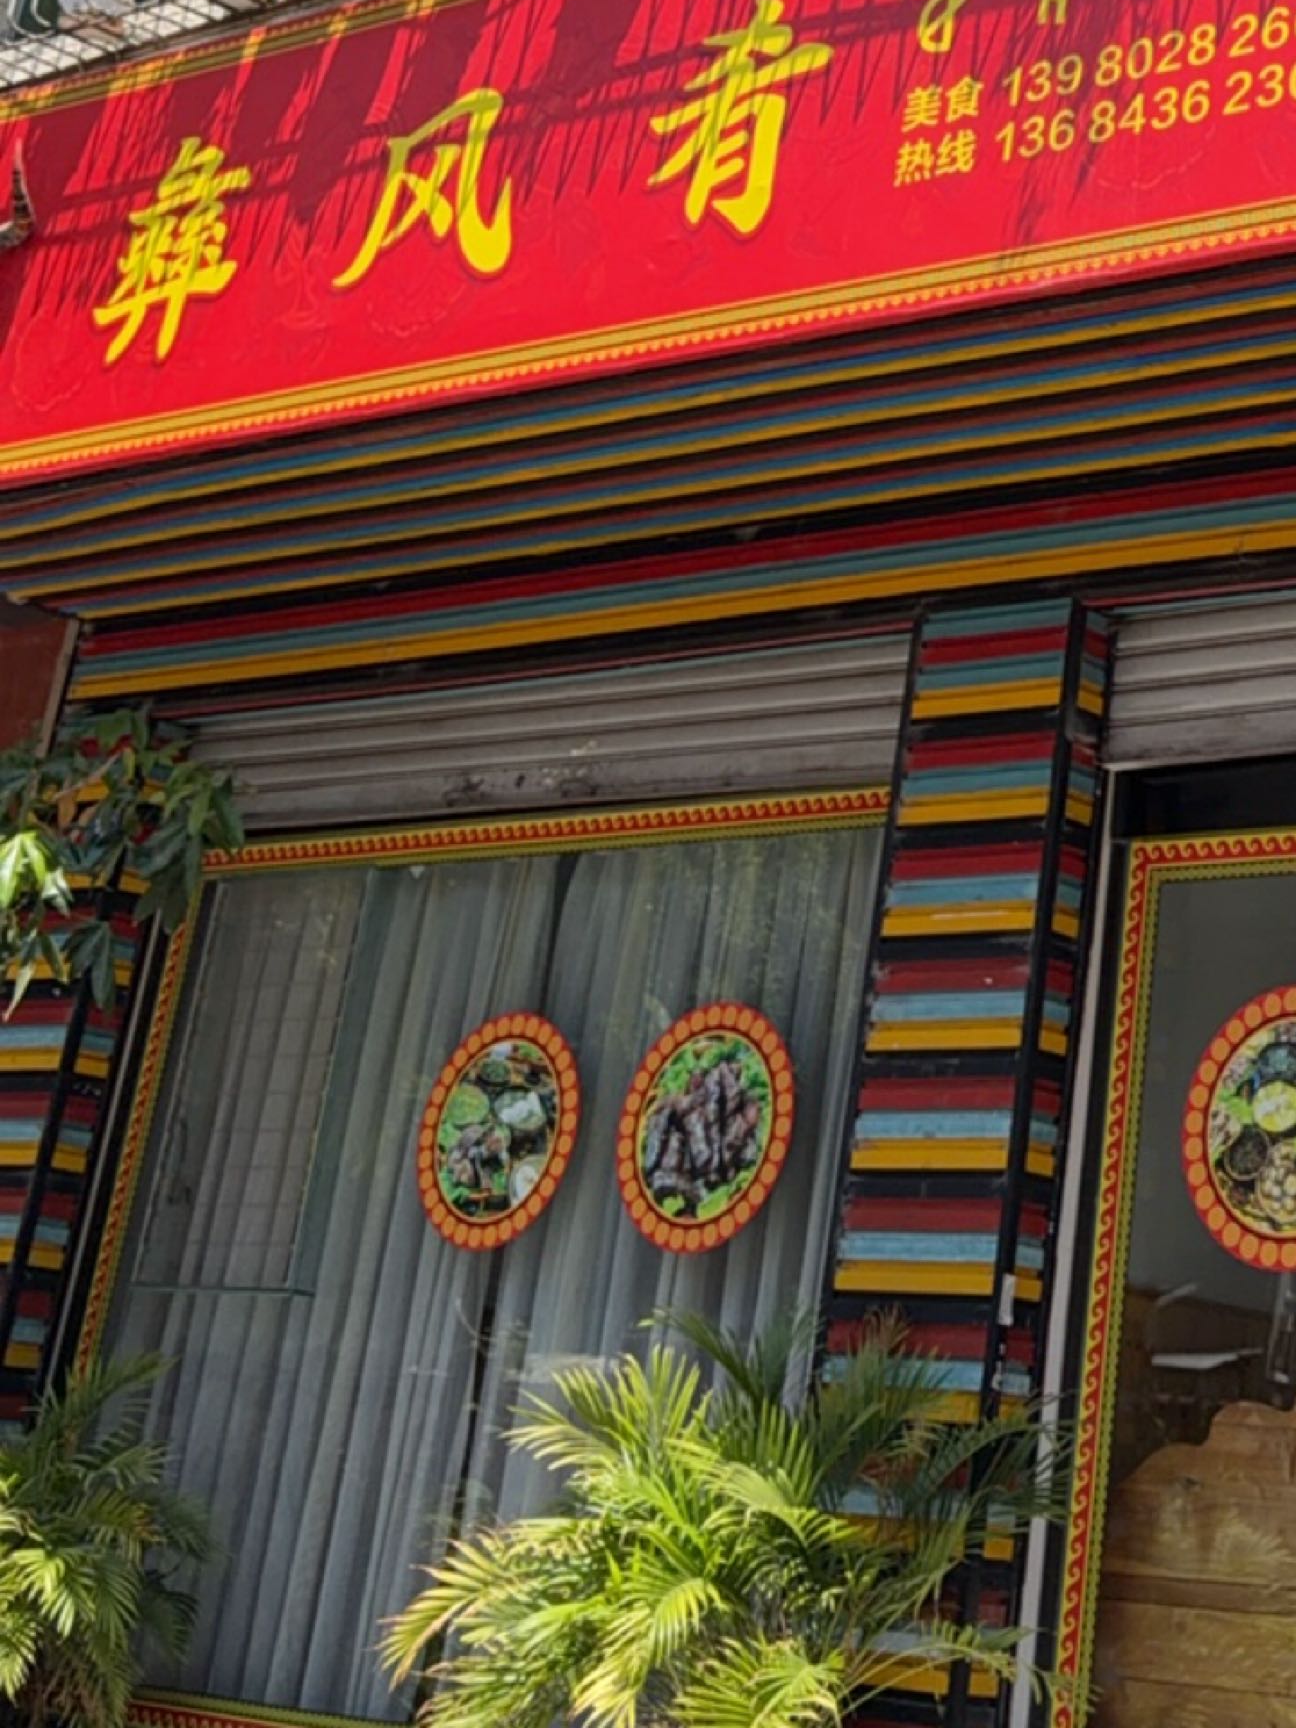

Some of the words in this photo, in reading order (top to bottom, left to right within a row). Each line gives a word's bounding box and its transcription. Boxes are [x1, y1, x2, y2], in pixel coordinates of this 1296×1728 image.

[901, 76, 984, 133] 美食
[1003, 55, 1083, 108] 139
[1095, 24, 1217, 87] 8028
[893, 129, 977, 187] 热线
[996, 109, 1075, 162] 136
[1088, 80, 1211, 143] 8436
